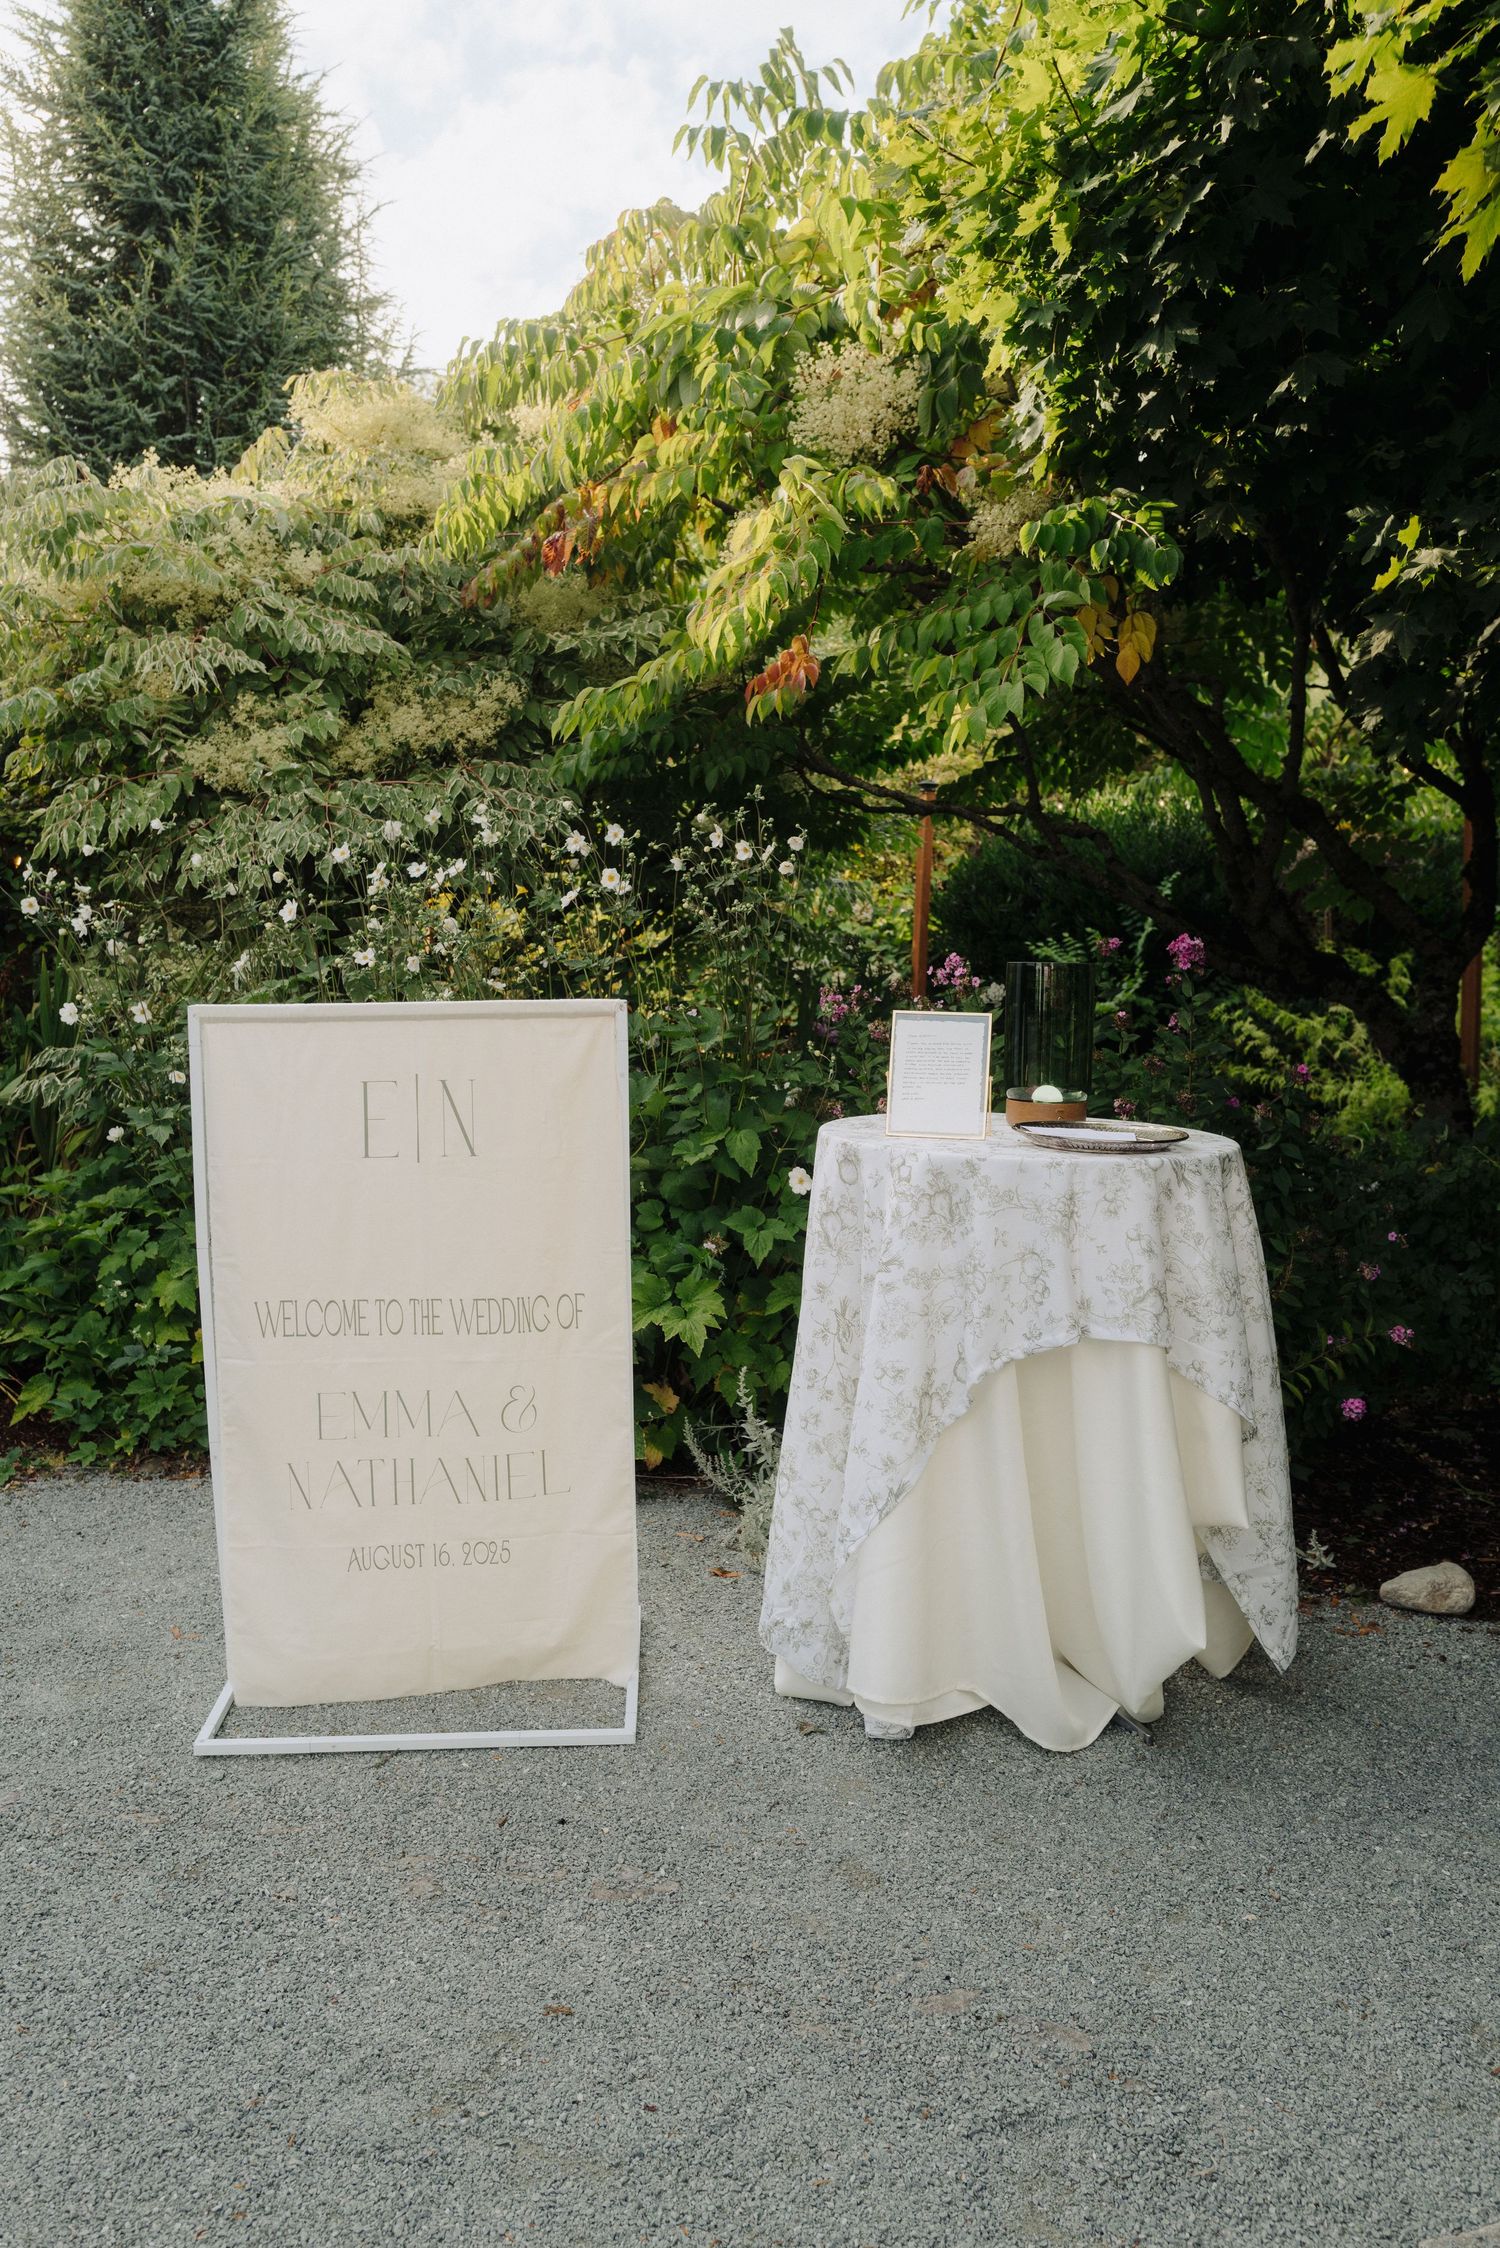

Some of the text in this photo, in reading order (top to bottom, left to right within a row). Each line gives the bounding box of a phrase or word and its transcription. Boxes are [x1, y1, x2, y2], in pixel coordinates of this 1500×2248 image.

[254, 1293, 585, 1338] WELCOME TO THE WEDDING OF
[317, 1385, 537, 1440] EMMA &
[287, 1450, 571, 1510] NATHANIEL
[347, 1543, 425, 1572] AUGUST
[462, 1540, 511, 1566] 2025
